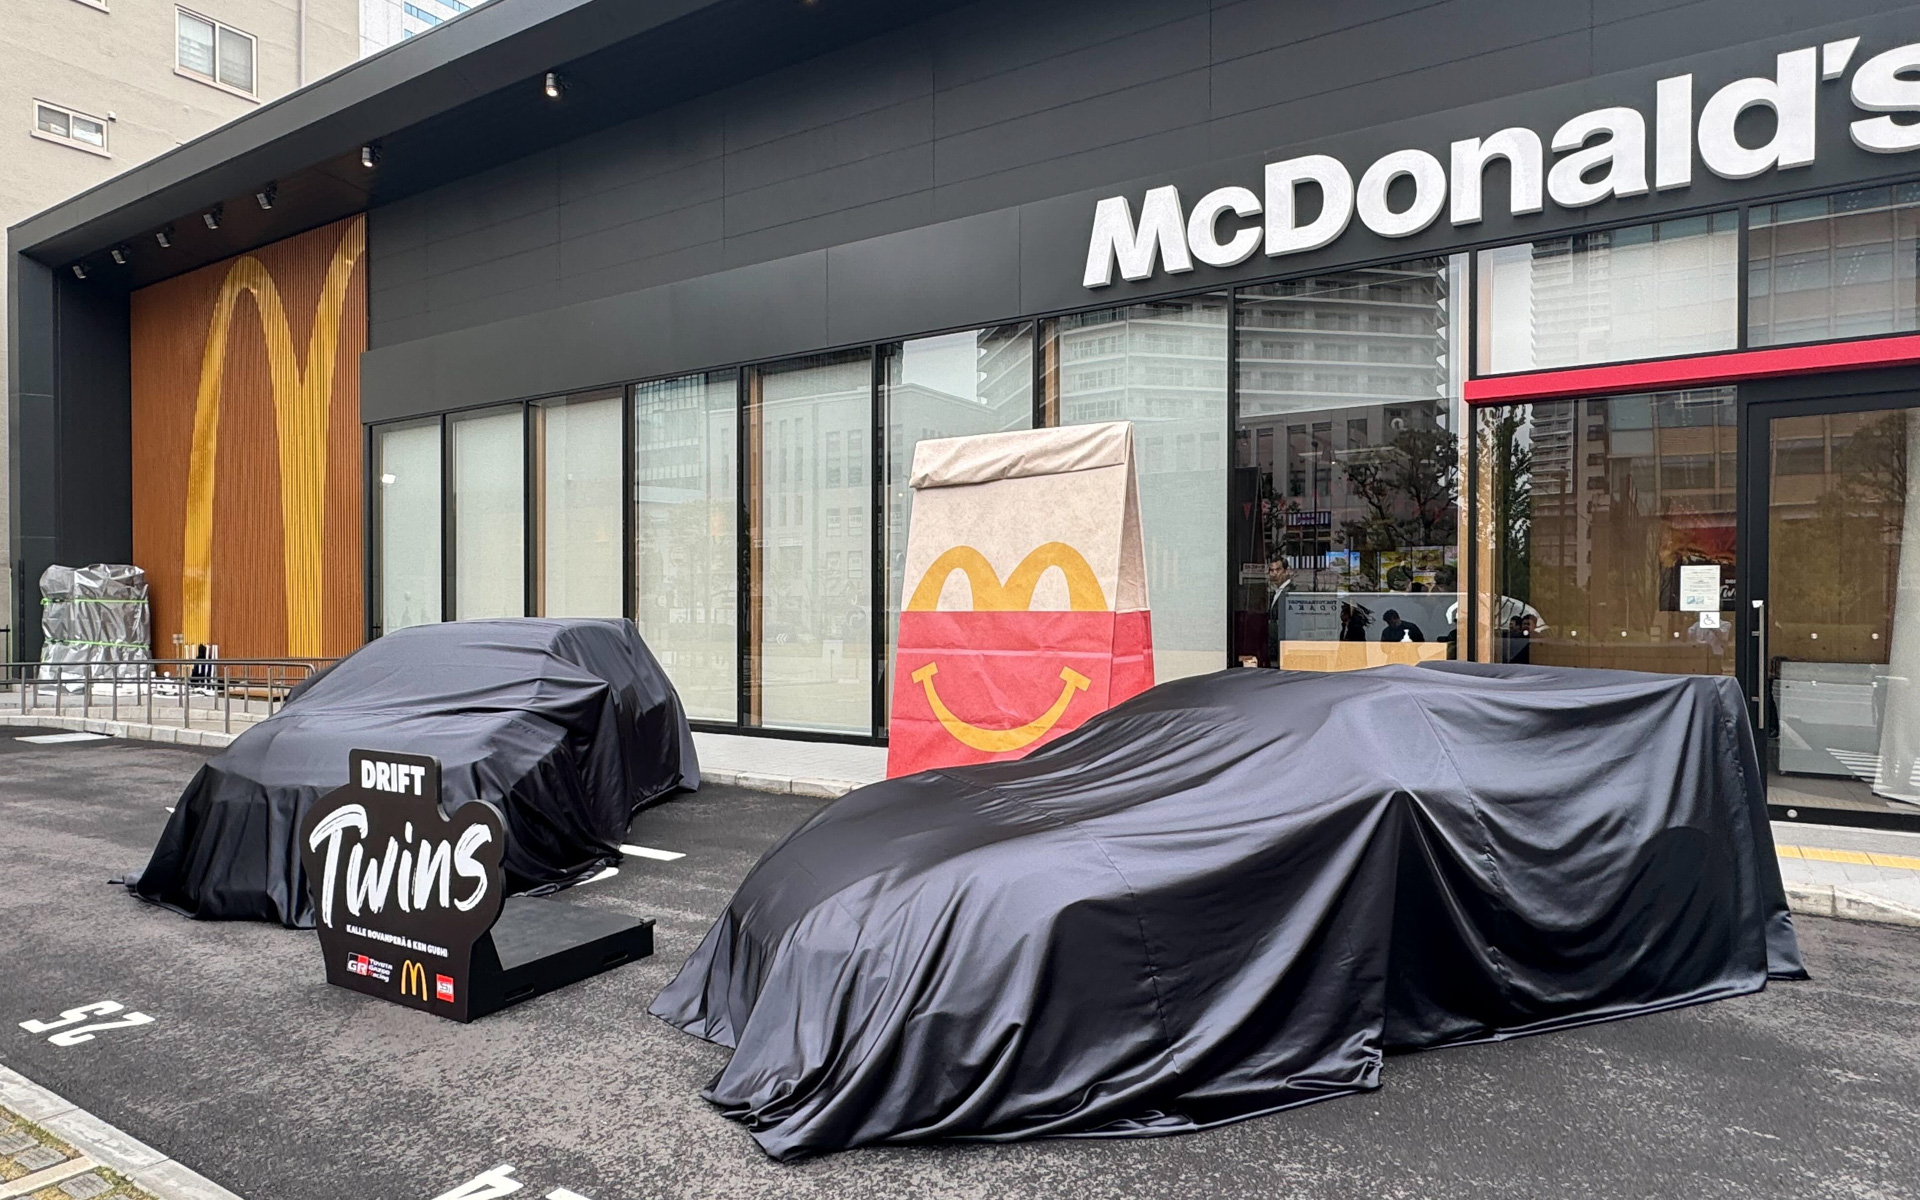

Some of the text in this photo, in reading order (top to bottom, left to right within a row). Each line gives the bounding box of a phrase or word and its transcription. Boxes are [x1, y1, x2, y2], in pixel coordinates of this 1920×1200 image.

[361, 760, 425, 795] DRIFT
[309, 804, 492, 928] Twins
[346, 924, 367, 936] KALLE
[412, 941, 427, 953] KEN
[347, 960, 368, 976] GR
[368, 965, 391, 976] GAZOO
[369, 958, 393, 970] TOYOTA
